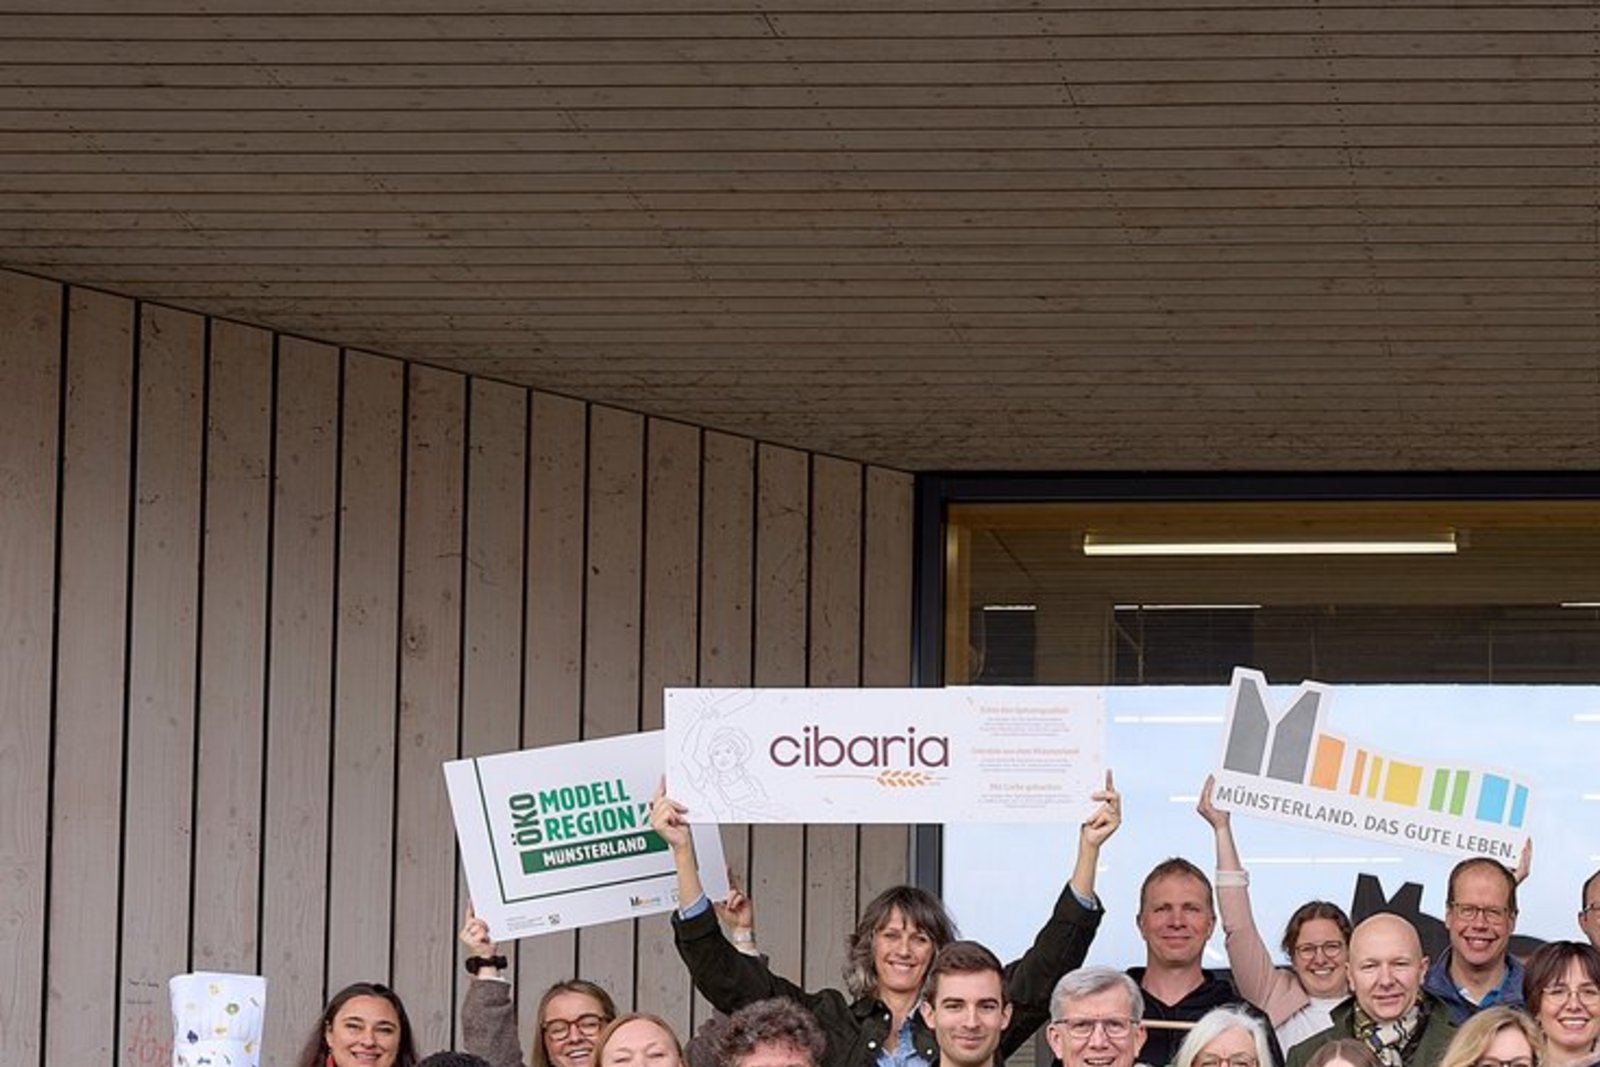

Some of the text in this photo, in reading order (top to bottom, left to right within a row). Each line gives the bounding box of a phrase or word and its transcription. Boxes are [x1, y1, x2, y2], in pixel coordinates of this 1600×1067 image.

[770, 726, 948, 767] cibaria
[539, 779, 630, 814] MODELL
[509, 793, 542, 845] ÖKO
[545, 805, 636, 841] REGION
[1216, 786, 1517, 859] MÜNSTERLAND. DAS GUTE LEBEN.
